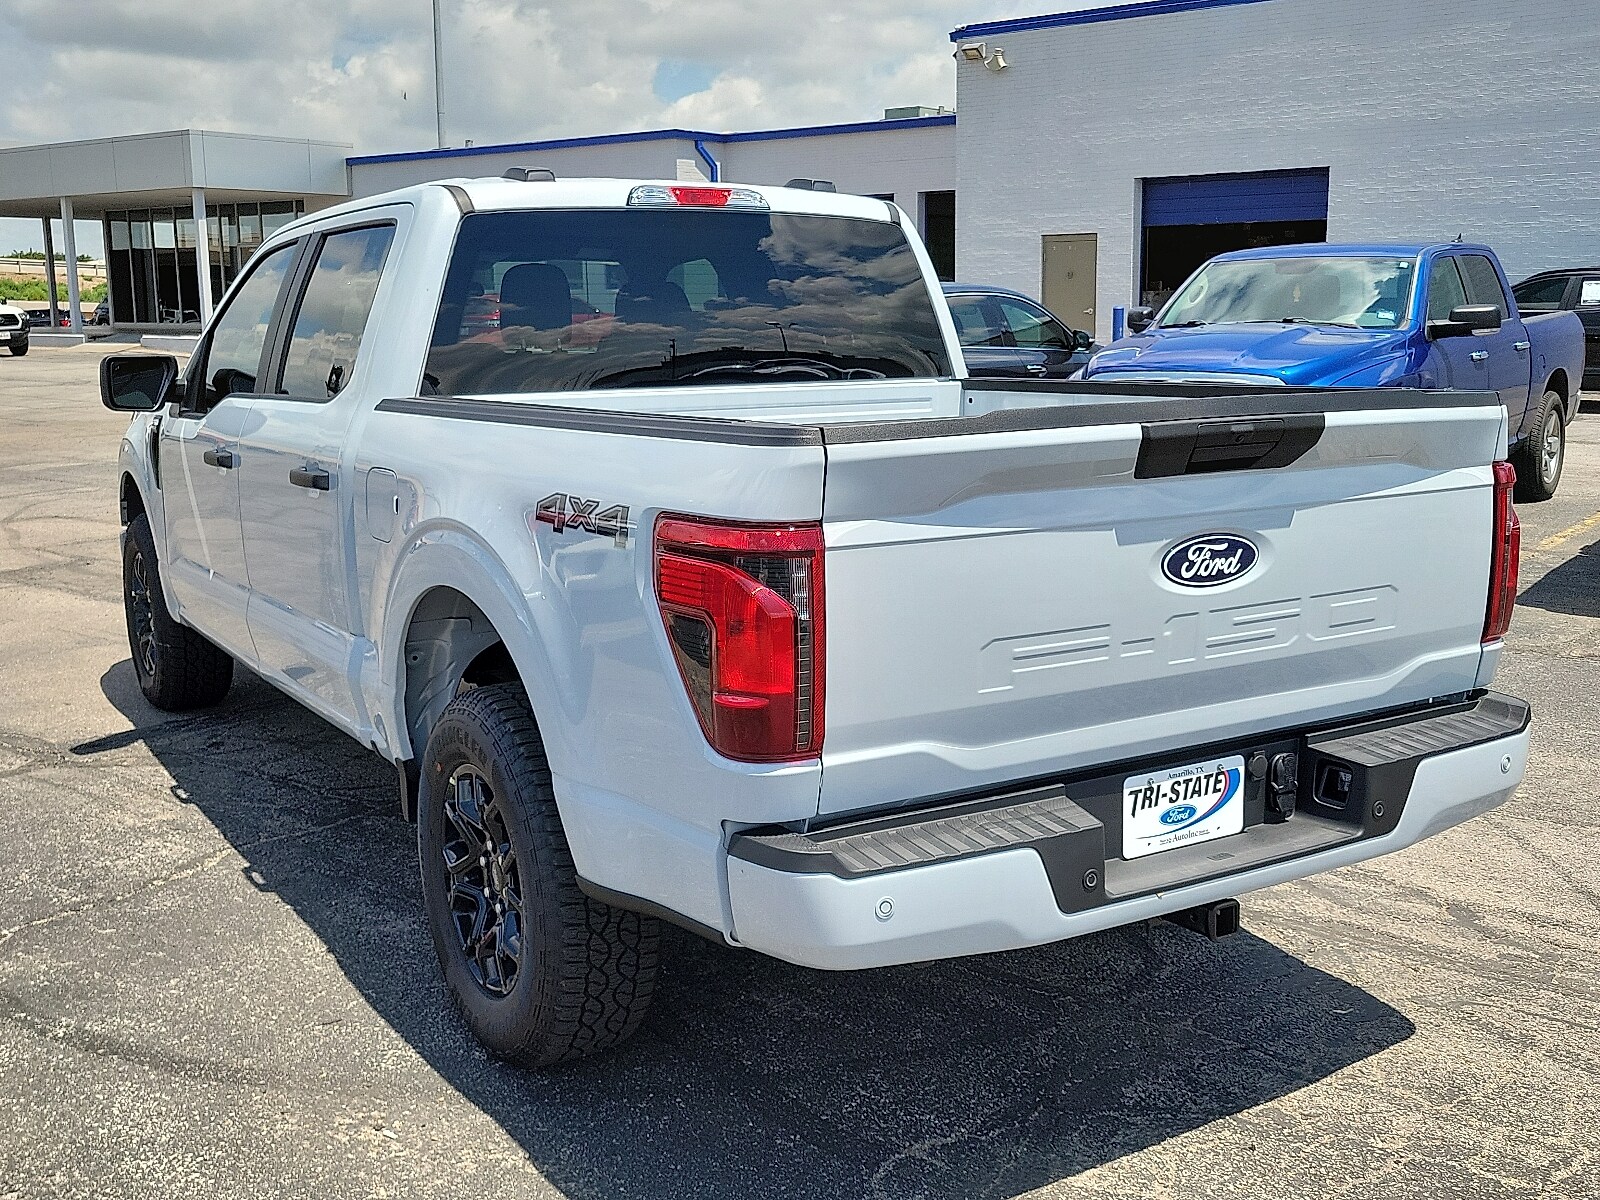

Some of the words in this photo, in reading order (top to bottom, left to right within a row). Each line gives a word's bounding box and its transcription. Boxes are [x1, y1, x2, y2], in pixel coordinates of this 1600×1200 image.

[1180, 542, 1242, 578] Ford
[978, 583, 1399, 694] F-150
[1167, 768, 1195, 780] Amarillo,
[1195, 766, 1205, 774] TX
[1128, 771, 1225, 818] TRI-STATE
[1166, 807, 1191, 823] Ford
